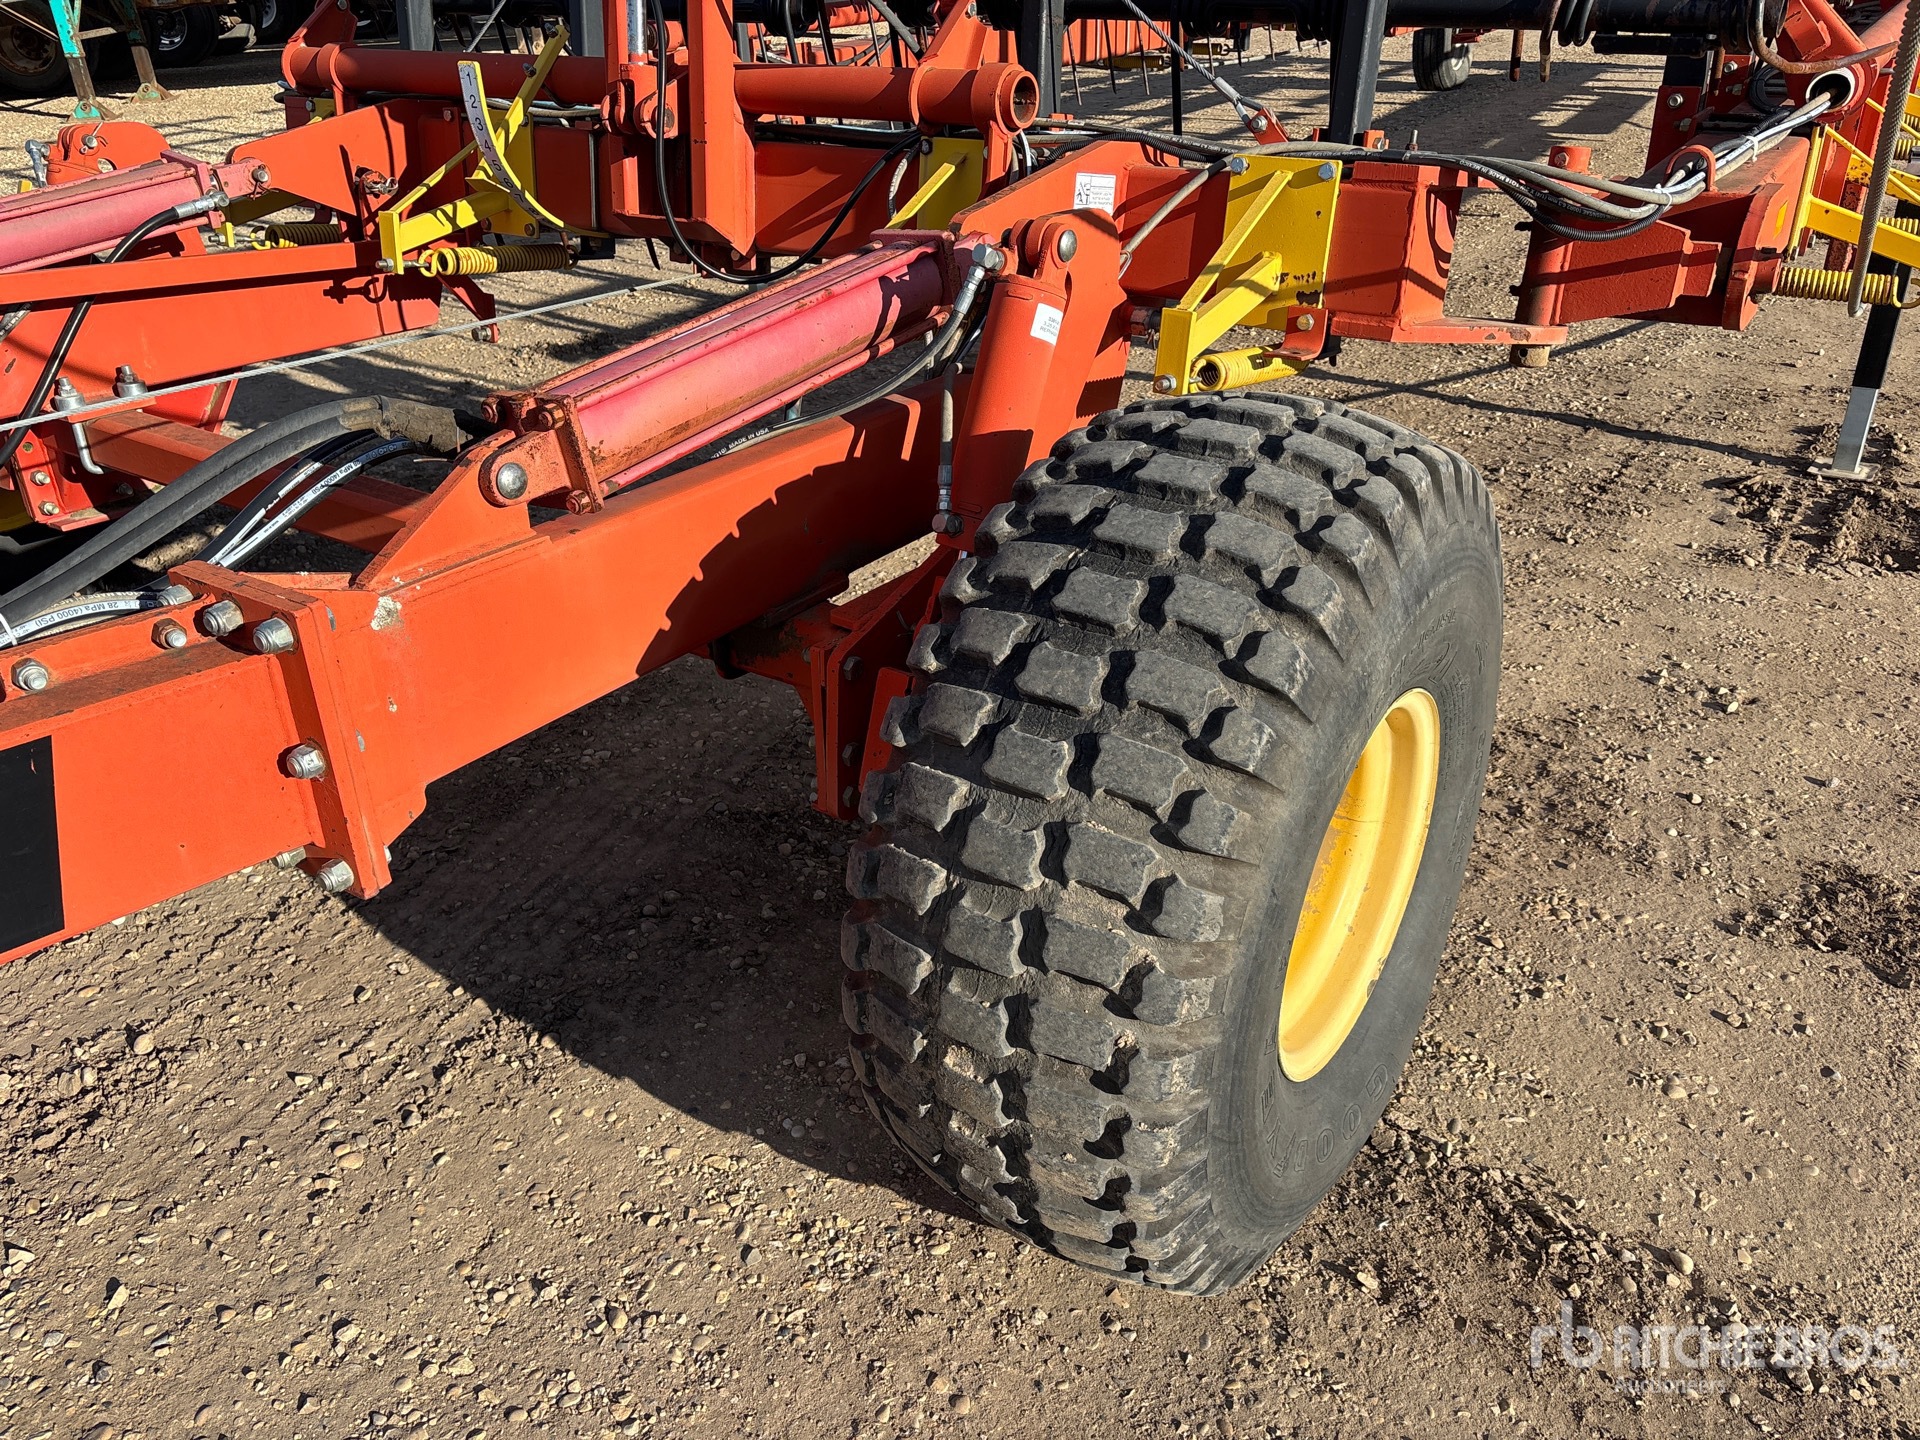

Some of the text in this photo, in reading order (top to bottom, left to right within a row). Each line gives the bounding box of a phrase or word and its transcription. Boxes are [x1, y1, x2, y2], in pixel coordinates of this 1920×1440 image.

[467, 72, 472, 86] 1
[469, 94, 478, 109] 2
[475, 117, 484, 132] 3
[484, 139, 492, 152] 4
[491, 159, 502, 172] 5
[1459, 160, 1481, 171] MEXICO
[1488, 170, 1505, 181] MADE
[503, 177, 514, 189] 6
[728, 436, 748, 449] MADE
[755, 427, 770, 438] USA
[338, 464, 352, 474] MPa
[323, 471, 340, 486] (4000
[83, 603, 106, 615] MPa
[107, 601, 119, 609] 28
[56, 606, 84, 621] (4000
[34, 613, 56, 628] PSI)
